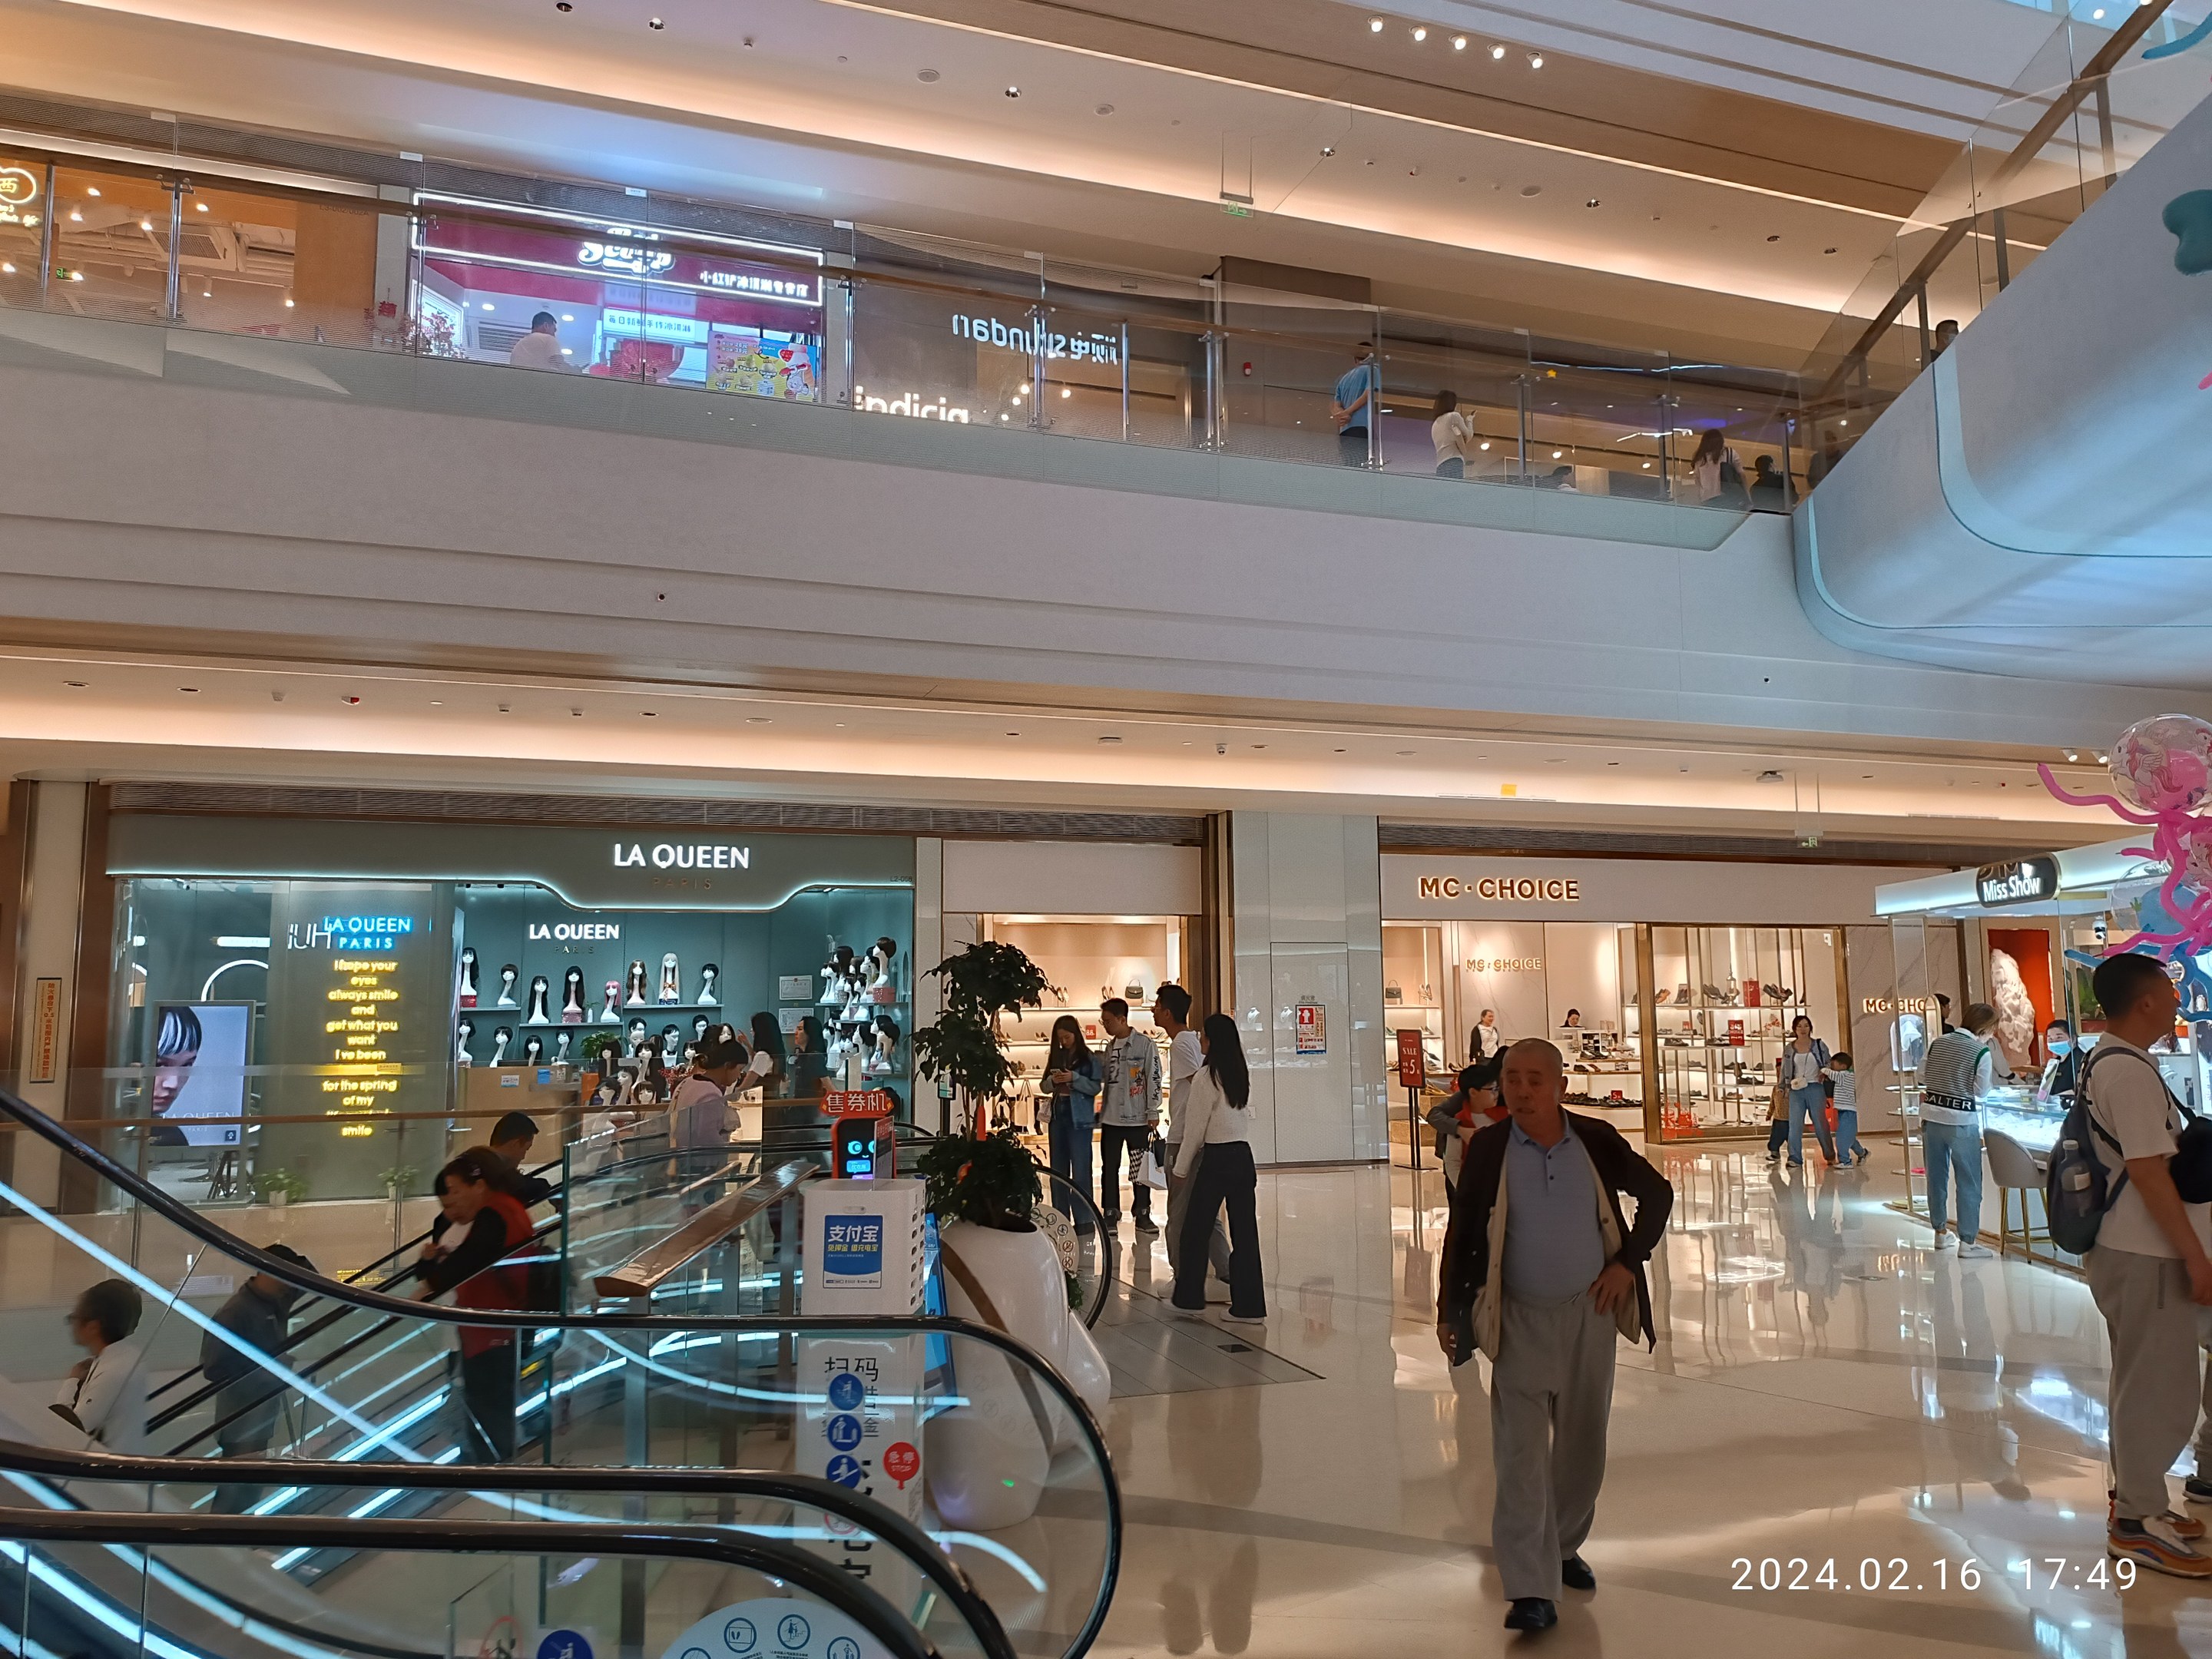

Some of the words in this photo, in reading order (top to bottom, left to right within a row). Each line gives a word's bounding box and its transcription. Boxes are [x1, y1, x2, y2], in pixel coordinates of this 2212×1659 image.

[614, 843, 646, 866] LA
[653, 844, 749, 869] QUEEN
[1982, 879, 2008, 902] Miss
[2008, 874, 2041, 897] Show
[323, 916, 344, 932] LA
[348, 916, 412, 933] QUEEN
[529, 924, 551, 939] LA
[555, 923, 619, 940] QUEEN
[339, 937, 392, 949] PARIS
[371, 962, 398, 973] your
[350, 976, 378, 987] eyes
[328, 989, 368, 1002] always
[368, 989, 399, 1001] smile
[351, 1004, 376, 1015] and
[326, 1019, 347, 1033] get
[347, 1019, 376, 1031] what
[376, 1021, 399, 1035] you
[346, 1034, 377, 1045] want
[356, 1050, 387, 1060] been
[323, 1080, 339, 1091] for
[340, 1079, 359, 1091] the
[359, 1080, 398, 1092] spring
[343, 1096, 356, 1105] of
[356, 1096, 375, 1107] my
[826, 1093, 886, 1113] 售券机
[342, 1124, 373, 1136] smile
[828, 1225, 879, 1243] 支付宝
[828, 1244, 848, 1253] 免押金
[851, 1244, 879, 1253] 借充电宝
[824, 1356, 879, 1382] 扫码
